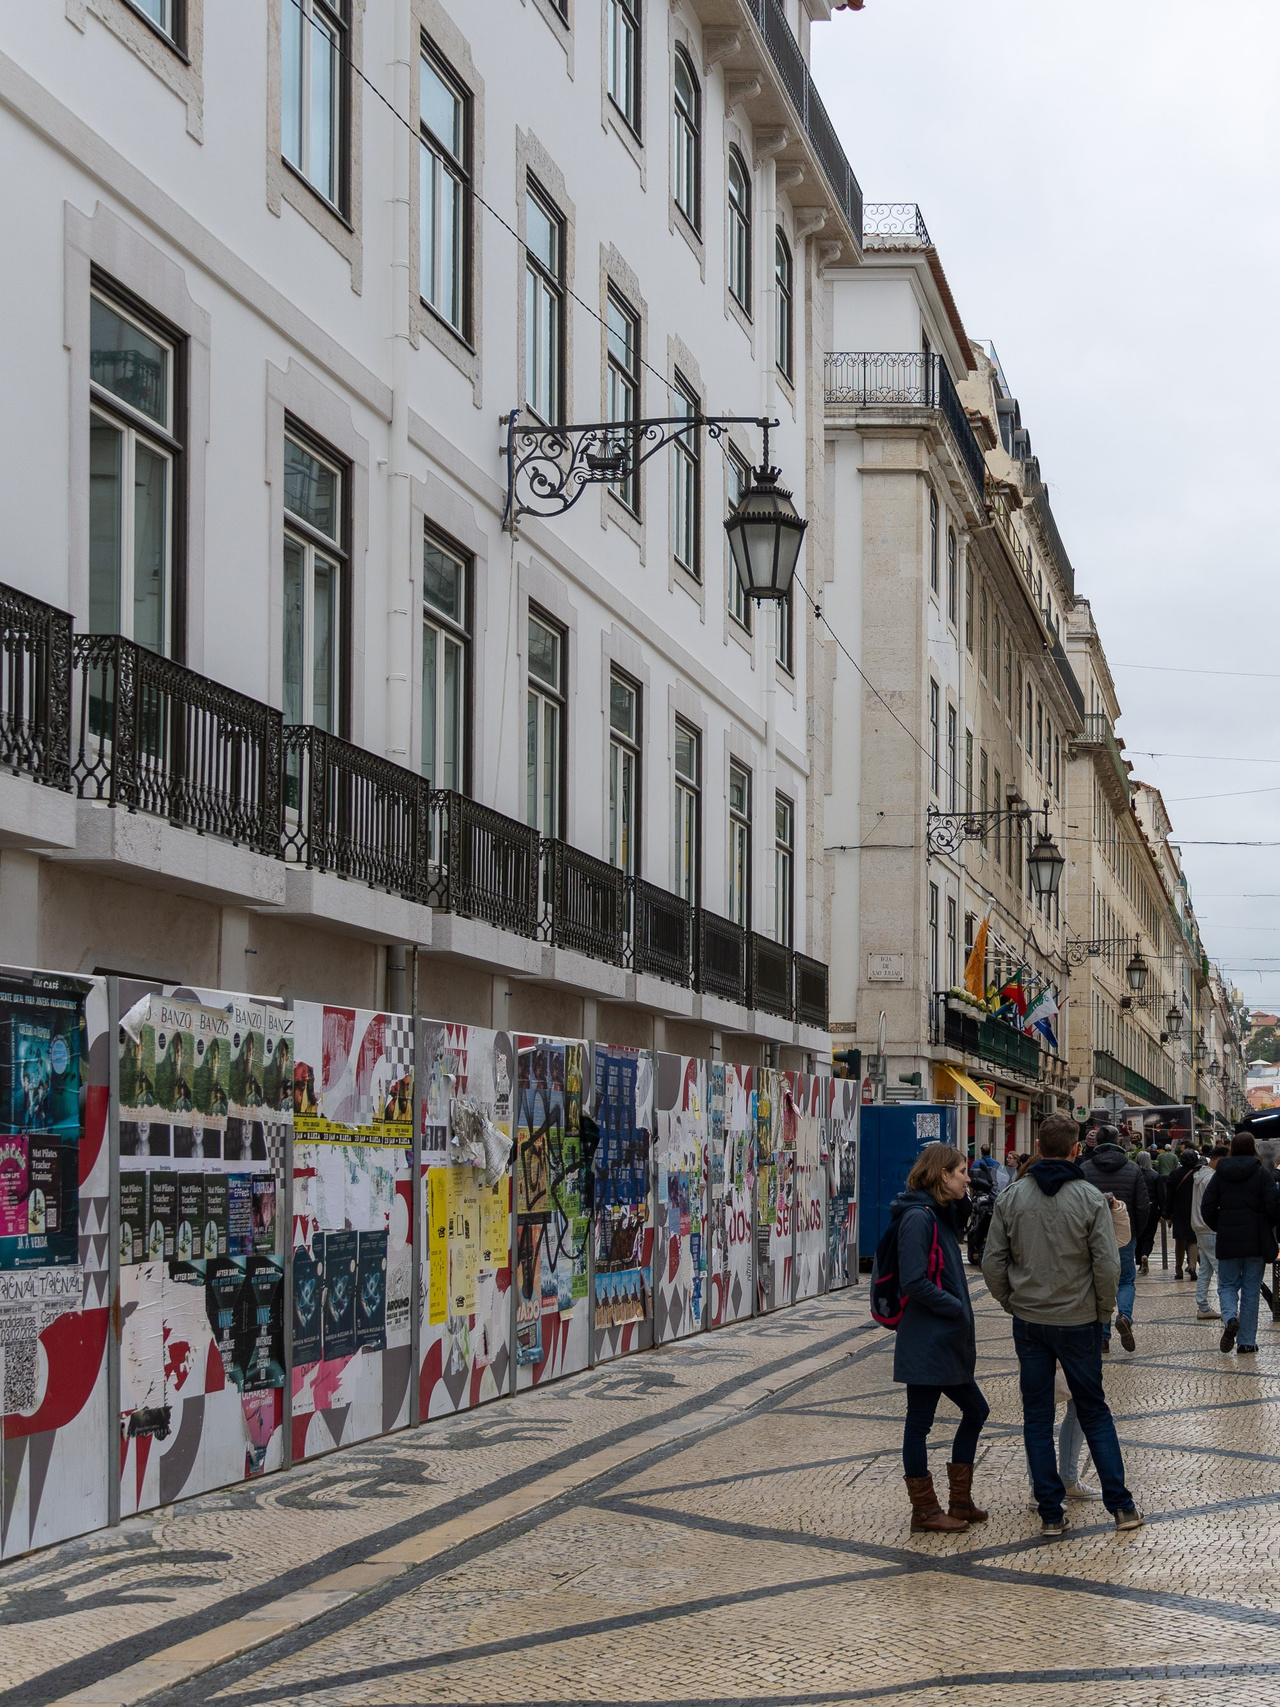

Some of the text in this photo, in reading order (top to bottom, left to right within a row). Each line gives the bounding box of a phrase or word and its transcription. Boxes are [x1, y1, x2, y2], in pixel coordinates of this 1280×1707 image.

[161, 1006, 192, 1029] BANZO
[235, 1008, 262, 1030] BANZO
[200, 1014, 229, 1036] BANZO
[268, 1014, 294, 1034] BANZ
[32, 1149, 57, 1158] Mat Pilates
[32, 1161, 51, 1169] Teacher
[32, 1172, 52, 1182] Training
[121, 1206, 138, 1215] Training
[153, 1205, 170, 1214] Training
[182, 1206, 198, 1214] Training
[208, 1207, 222, 1215] Training
[31, 1236, 48, 1248] VENDA
[386, 1297, 409, 1312] AROUND
[1, 1327, 37, 1340] 03/02/2025
